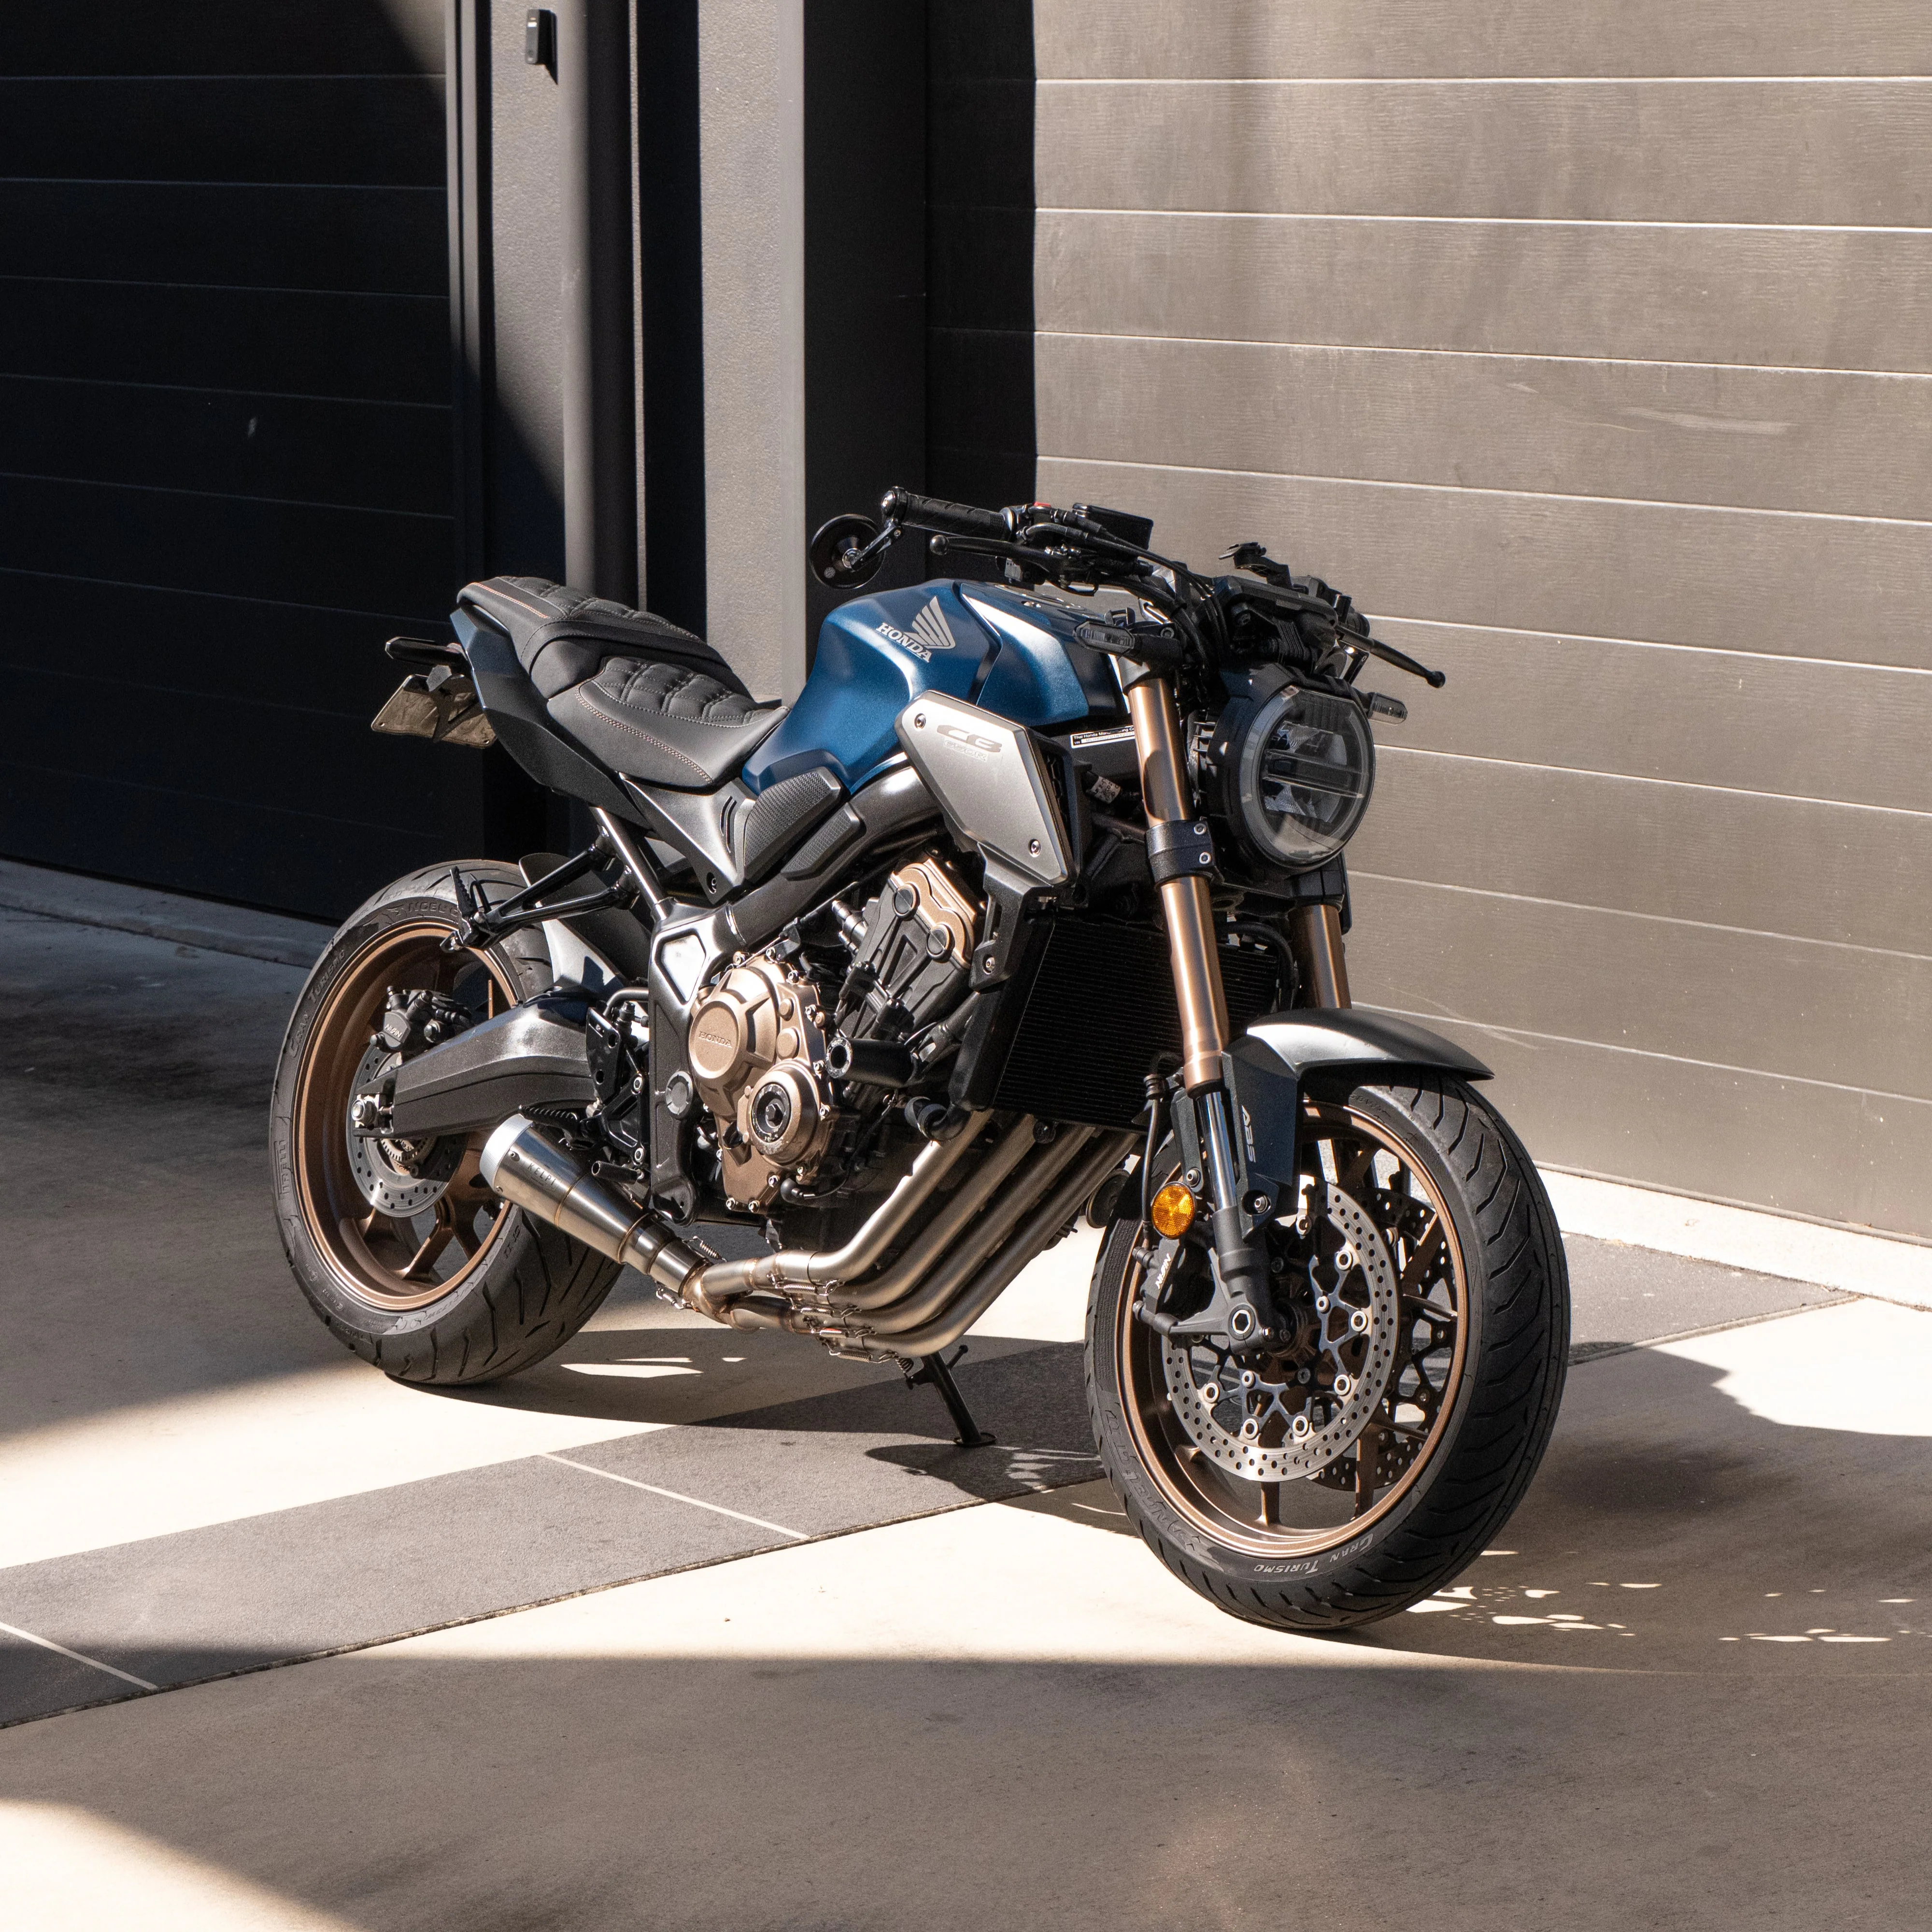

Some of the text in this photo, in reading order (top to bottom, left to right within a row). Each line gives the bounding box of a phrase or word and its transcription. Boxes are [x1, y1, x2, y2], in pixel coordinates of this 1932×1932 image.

[876, 622, 932, 663] HONDA
[937, 724, 1002, 753] CB
[698, 1031, 733, 1049] HONDA
[1241, 1105, 1256, 1163] ABS
[1253, 1533, 1374, 1575] GRAN TURISMO
